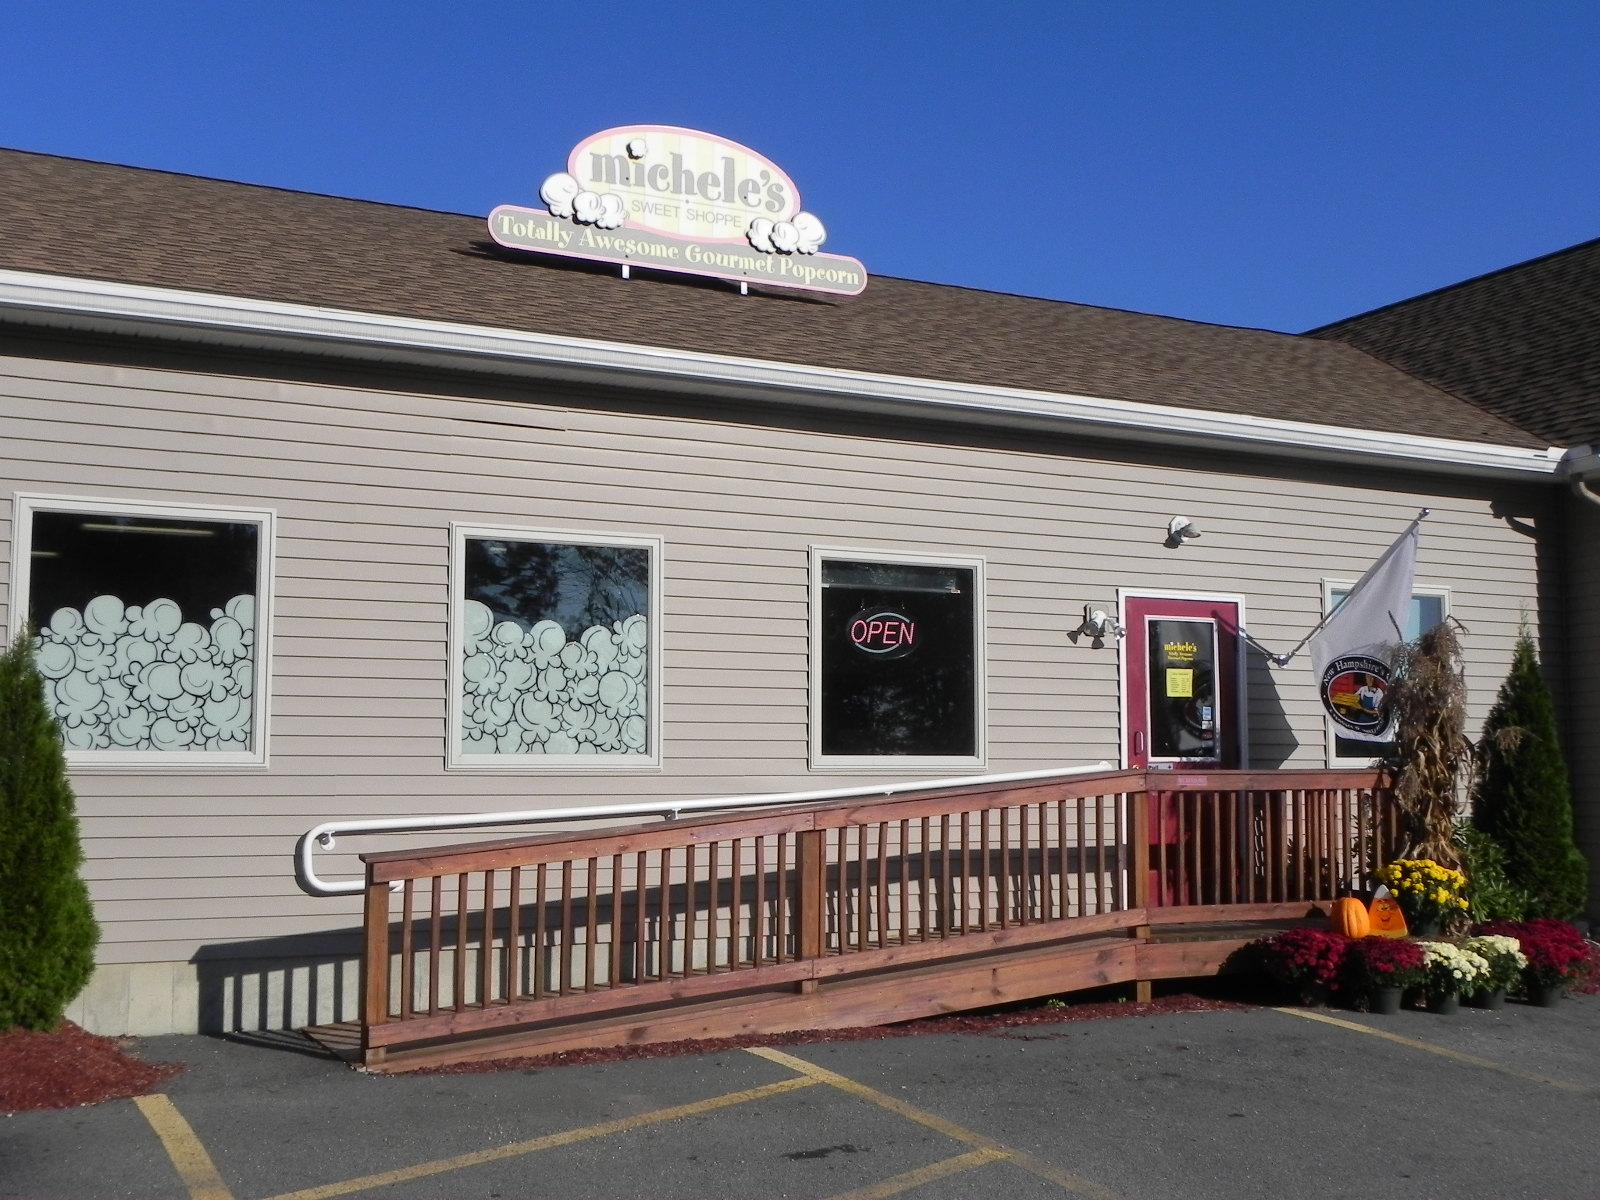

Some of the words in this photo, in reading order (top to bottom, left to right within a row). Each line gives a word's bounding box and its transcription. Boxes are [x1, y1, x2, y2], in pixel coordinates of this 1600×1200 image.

[589, 151, 786, 214] michele's
[631, 200, 681, 218] SWEET
[686, 208, 742, 228] SHOPPE
[498, 214, 575, 249] Totally
[579, 228, 679, 260] Awesome
[685, 244, 775, 274] Gourmet
[780, 256, 860, 286] Popcorn
[850, 619, 915, 645] OPEN
